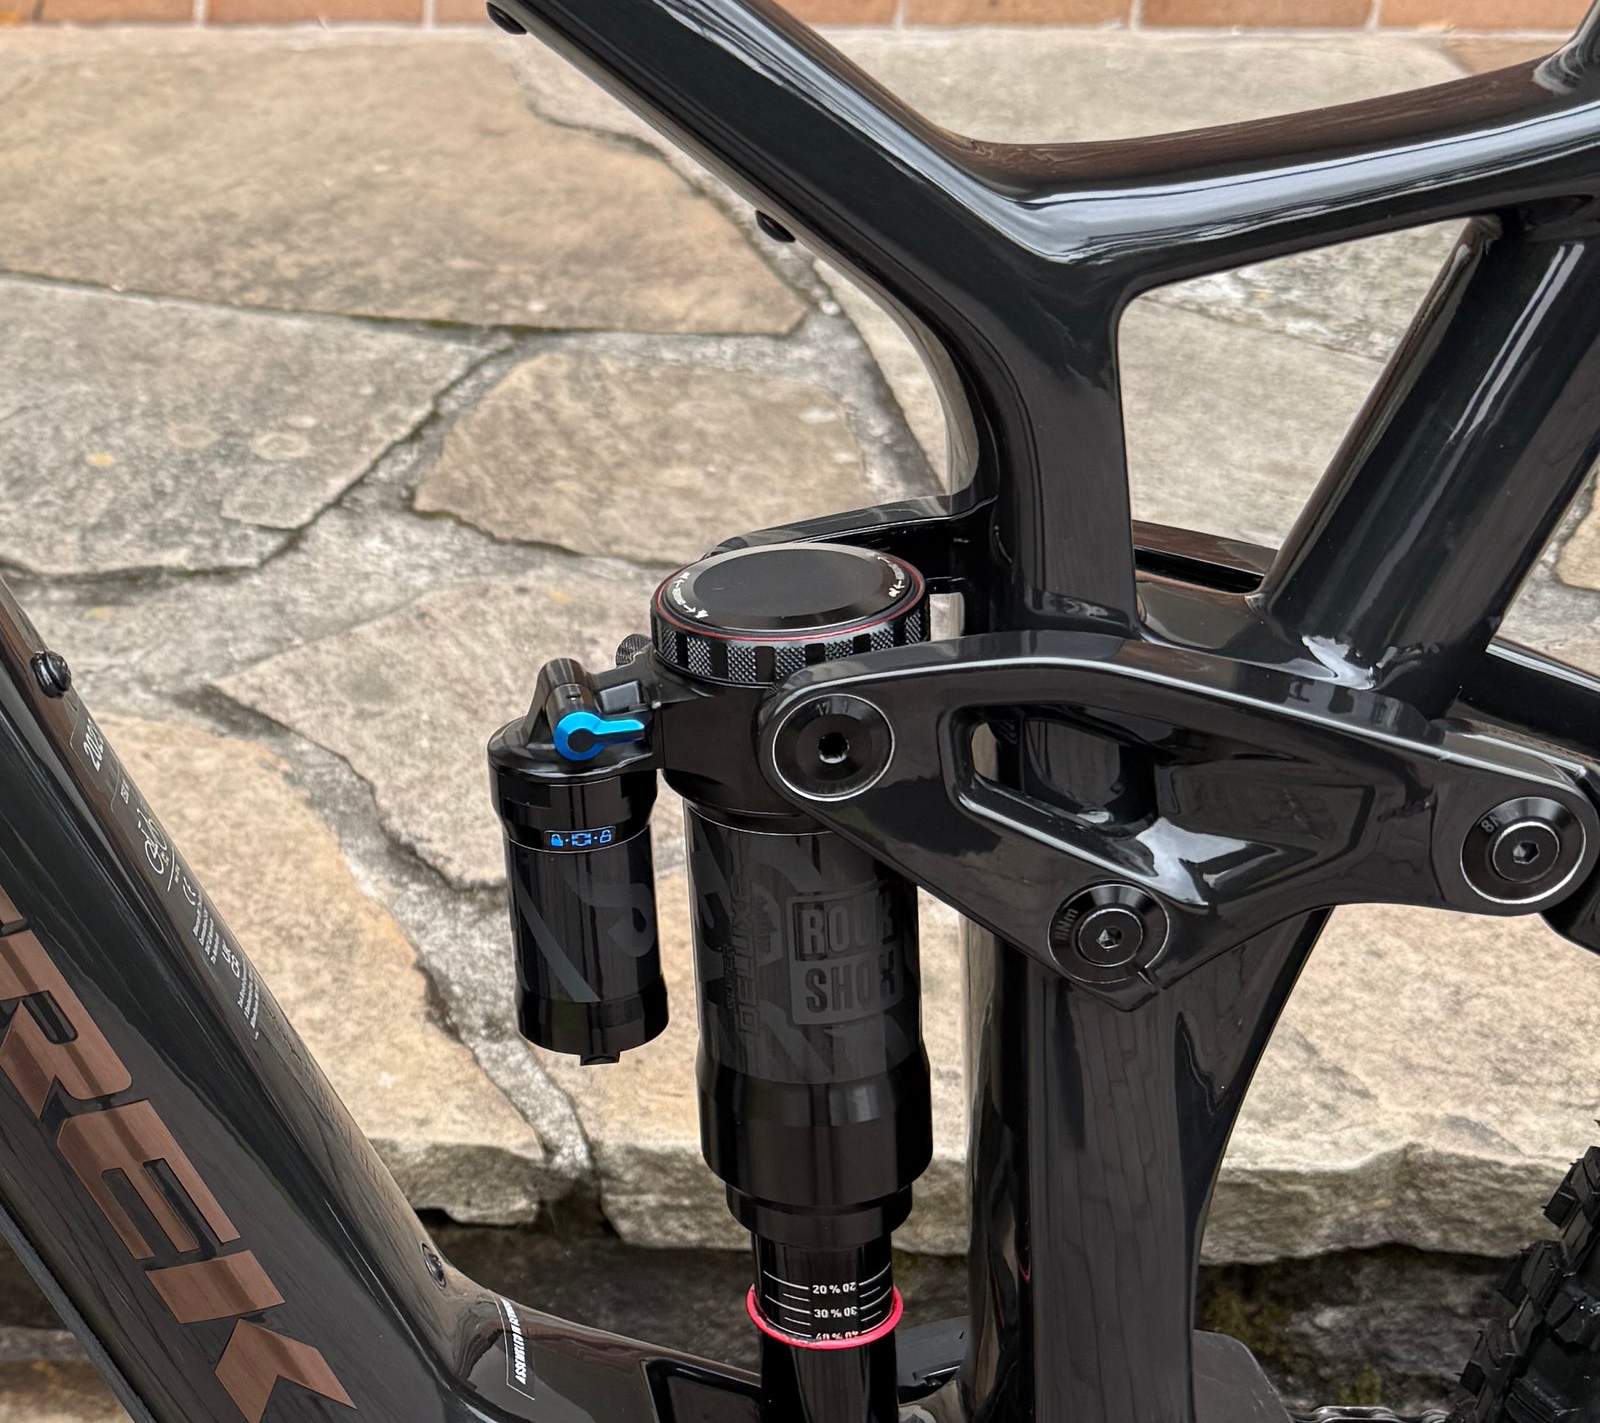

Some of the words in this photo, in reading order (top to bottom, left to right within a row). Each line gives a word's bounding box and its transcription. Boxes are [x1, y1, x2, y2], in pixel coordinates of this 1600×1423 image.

[802, 893, 894, 955] ROCK
[805, 950, 896, 1013] SHOX
[812, 1284, 828, 1295] 20
[813, 1308, 829, 1318] 30
